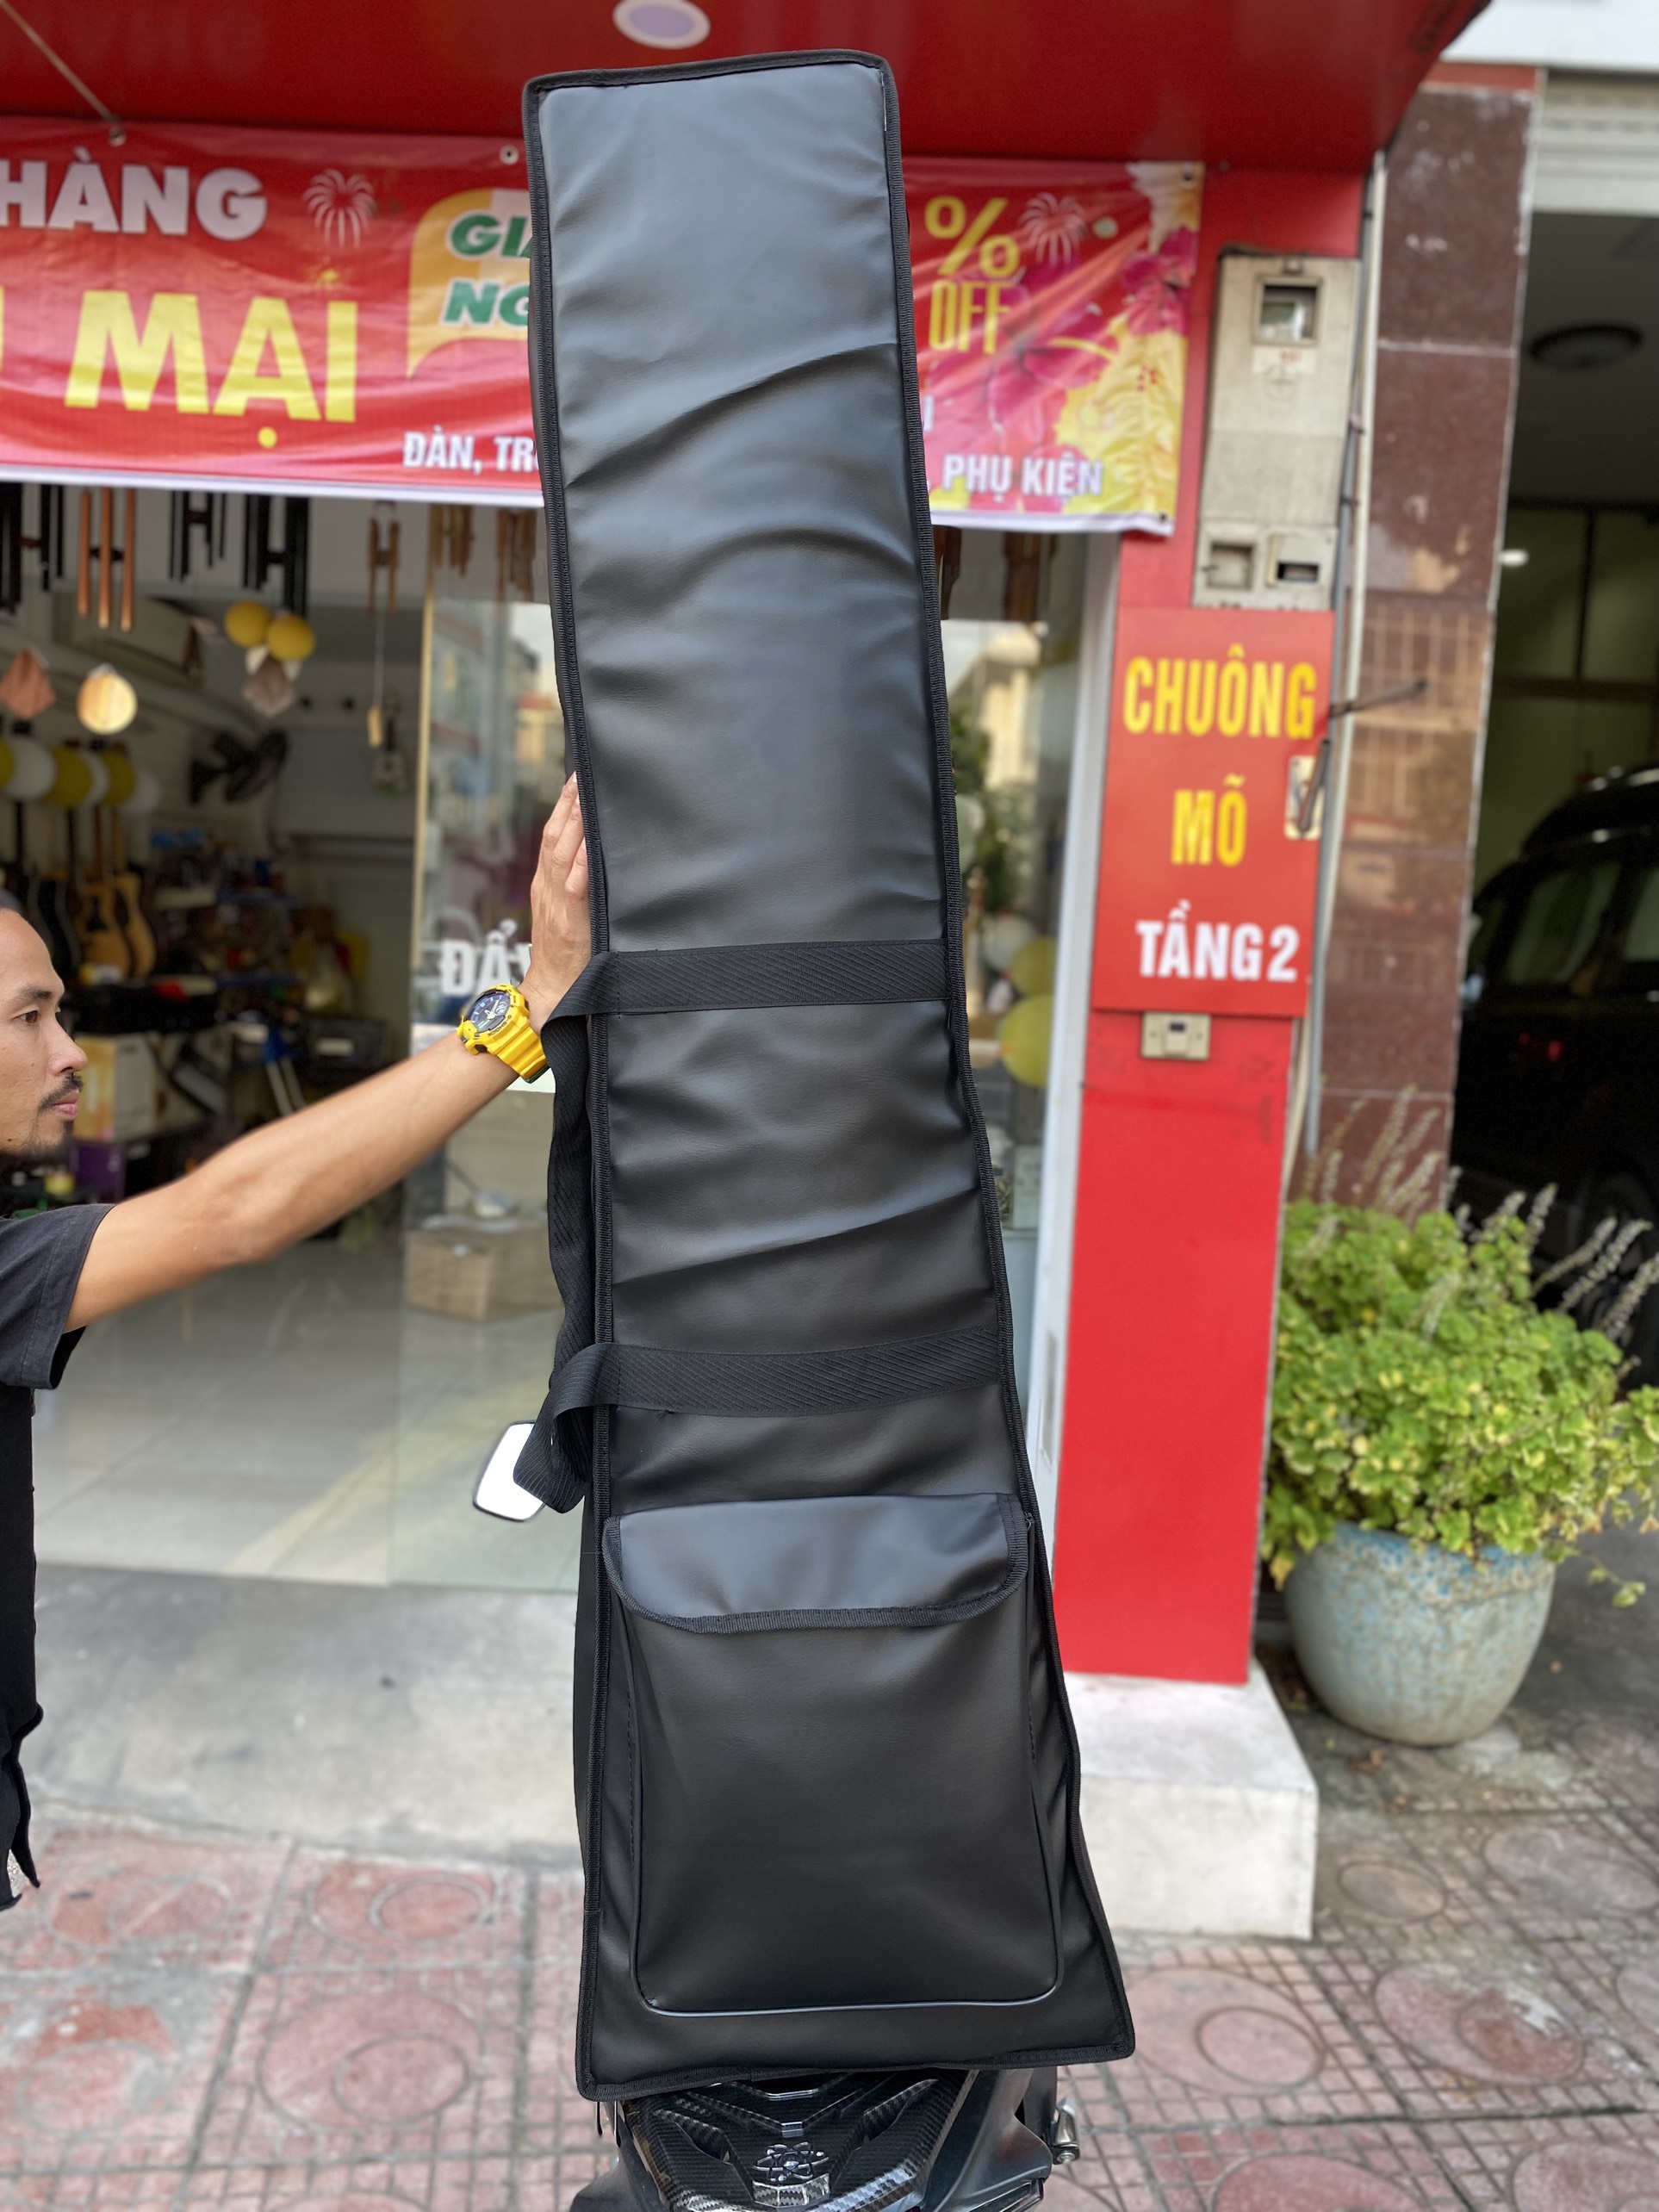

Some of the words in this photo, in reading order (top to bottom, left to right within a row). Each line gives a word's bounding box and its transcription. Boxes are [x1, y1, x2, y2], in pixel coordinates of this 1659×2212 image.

[0, 146, 267, 241] HÀNG
[450, 213, 532, 258] GI
[929, 279, 1015, 354] OFF
[65, 289, 358, 449] MẠI
[402, 424, 483, 475] ĐÀN,
[494, 435, 539, 473] TR
[943, 453, 1013, 504] PHỤ
[1021, 450, 1104, 505] KIỆN
[1123, 643, 1317, 740] CHUÔNG
[1171, 772, 1247, 867] MÕ
[1266, 924, 1300, 983] 2
[487, 1015, 513, 1038] G-SHOCK
